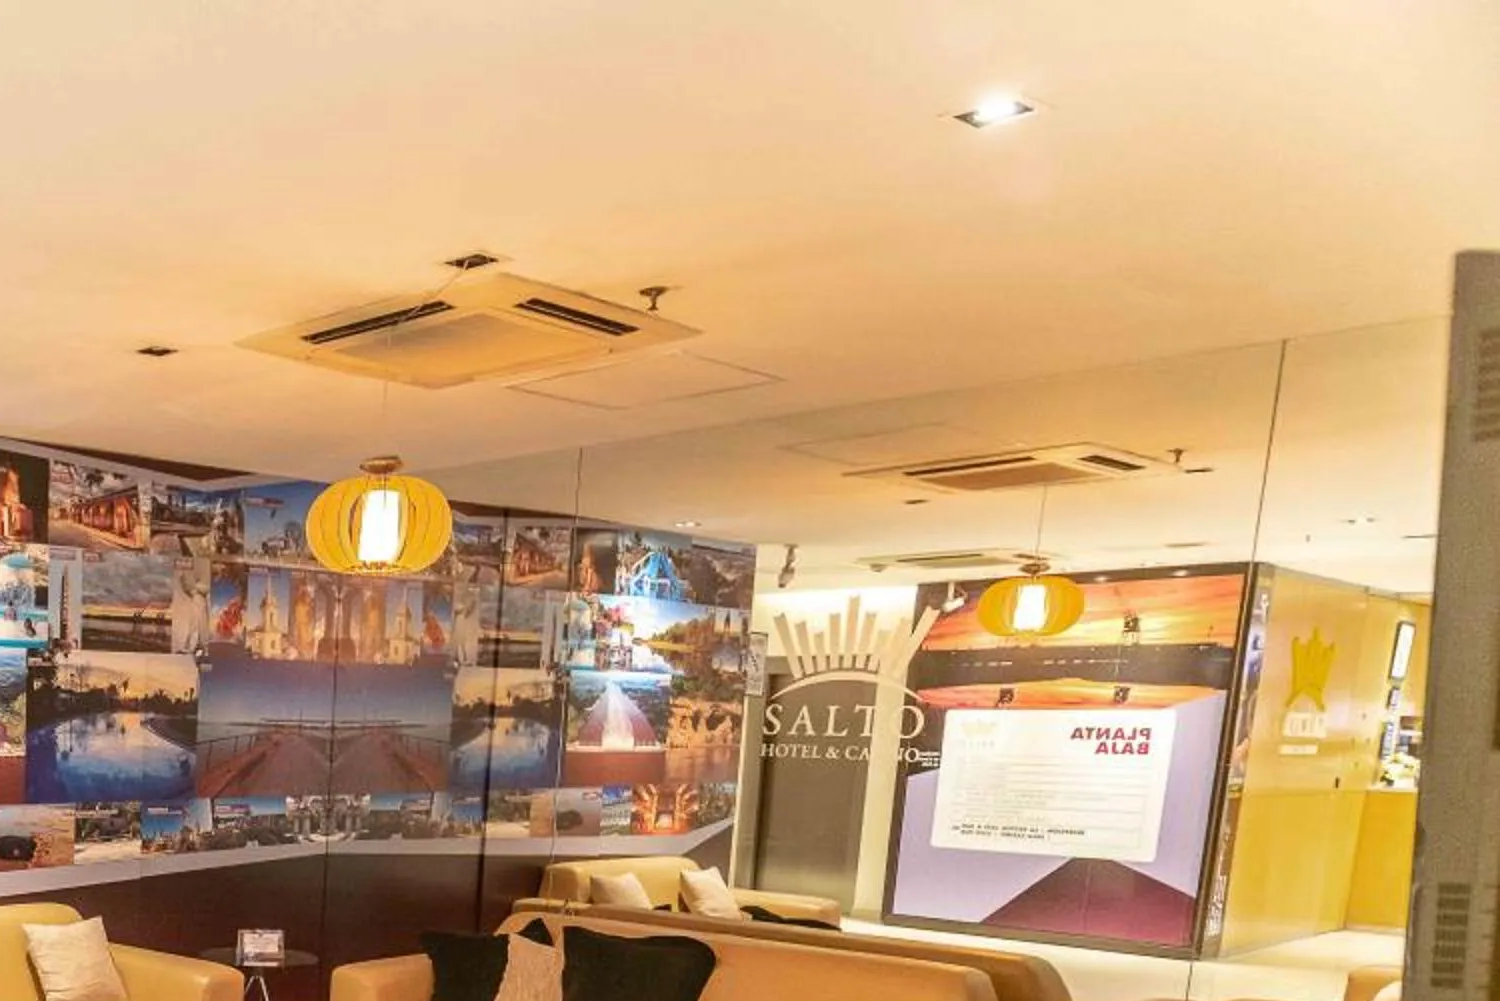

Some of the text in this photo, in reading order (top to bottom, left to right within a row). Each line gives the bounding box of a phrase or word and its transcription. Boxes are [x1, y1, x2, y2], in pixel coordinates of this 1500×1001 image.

[763, 703, 925, 739] SALTO
[760, 743, 822, 759] HOTEL
[825, 745, 841, 760] &
[844, 745, 920, 763] CAO
